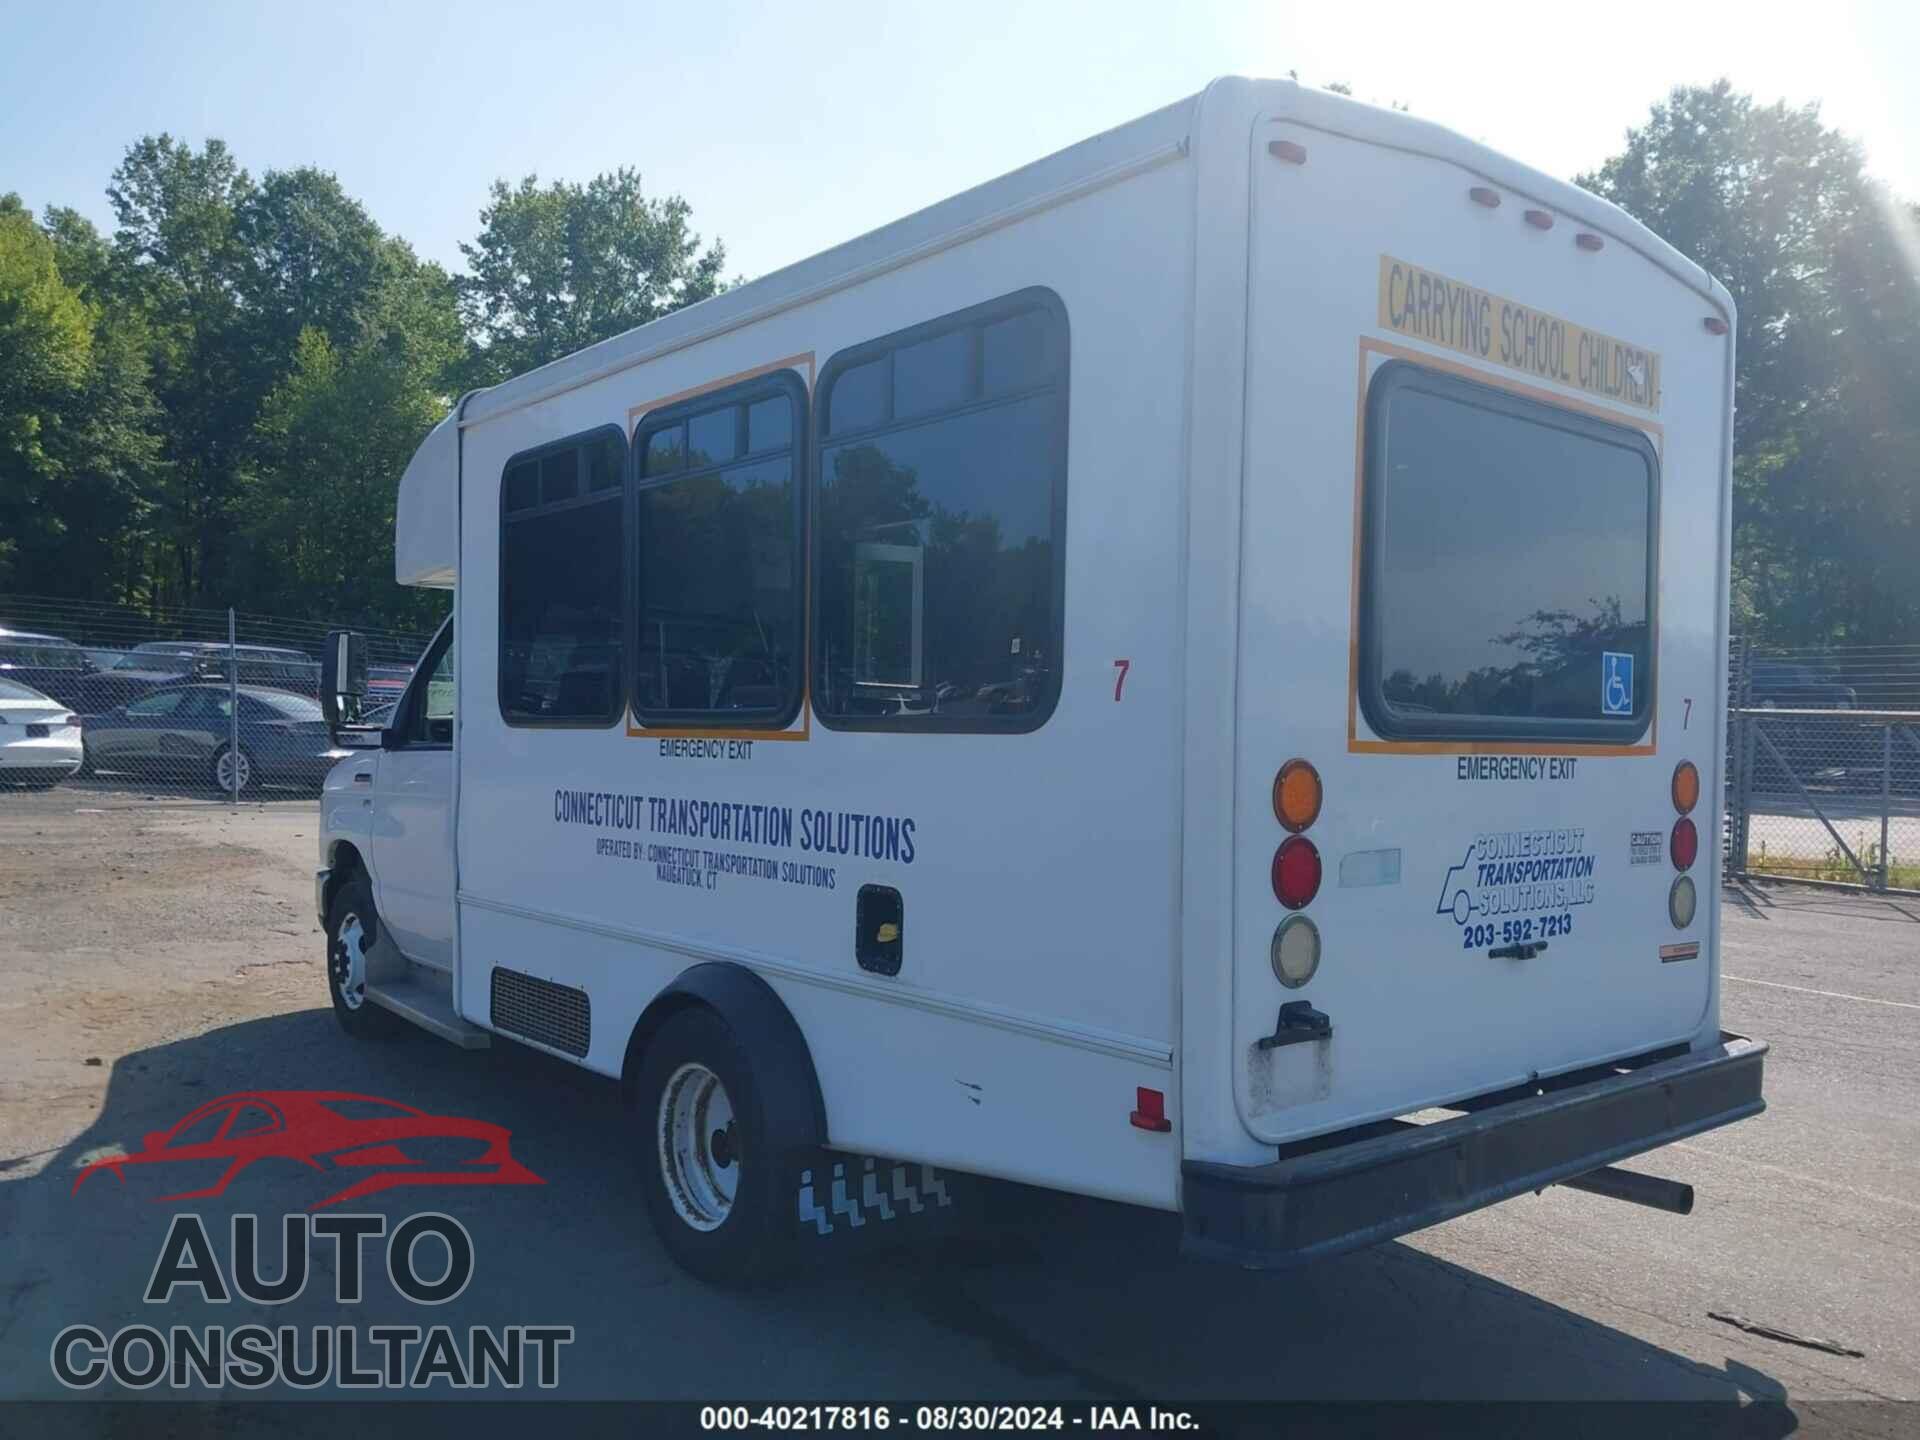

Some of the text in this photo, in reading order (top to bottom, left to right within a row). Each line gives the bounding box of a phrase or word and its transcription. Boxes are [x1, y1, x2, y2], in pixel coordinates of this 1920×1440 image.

[1388, 263, 1655, 407] CARRYING SCHOOL CHILDREN
[1114, 659, 1130, 702] 7
[1683, 698, 1693, 731] 7
[659, 738, 754, 761] EMERGENCY EXIT
[1457, 755, 1577, 781] EMERGENCY EXIT
[553, 788, 916, 865] CONNECTICUT TRANSPORTATION SOLUTIONS
[1475, 829, 1585, 862] CONNECTICUT
[596, 838, 632, 859] OPERATED
[647, 844, 700, 869] CONNECTICUT
[703, 850, 779, 881] TRANSPORTATION
[781, 861, 836, 891] SOLUTIONS
[706, 871, 718, 891] CT
[1476, 855, 1596, 888] TRANSPORTATION
[1463, 913, 1572, 949] 203-592-7213
